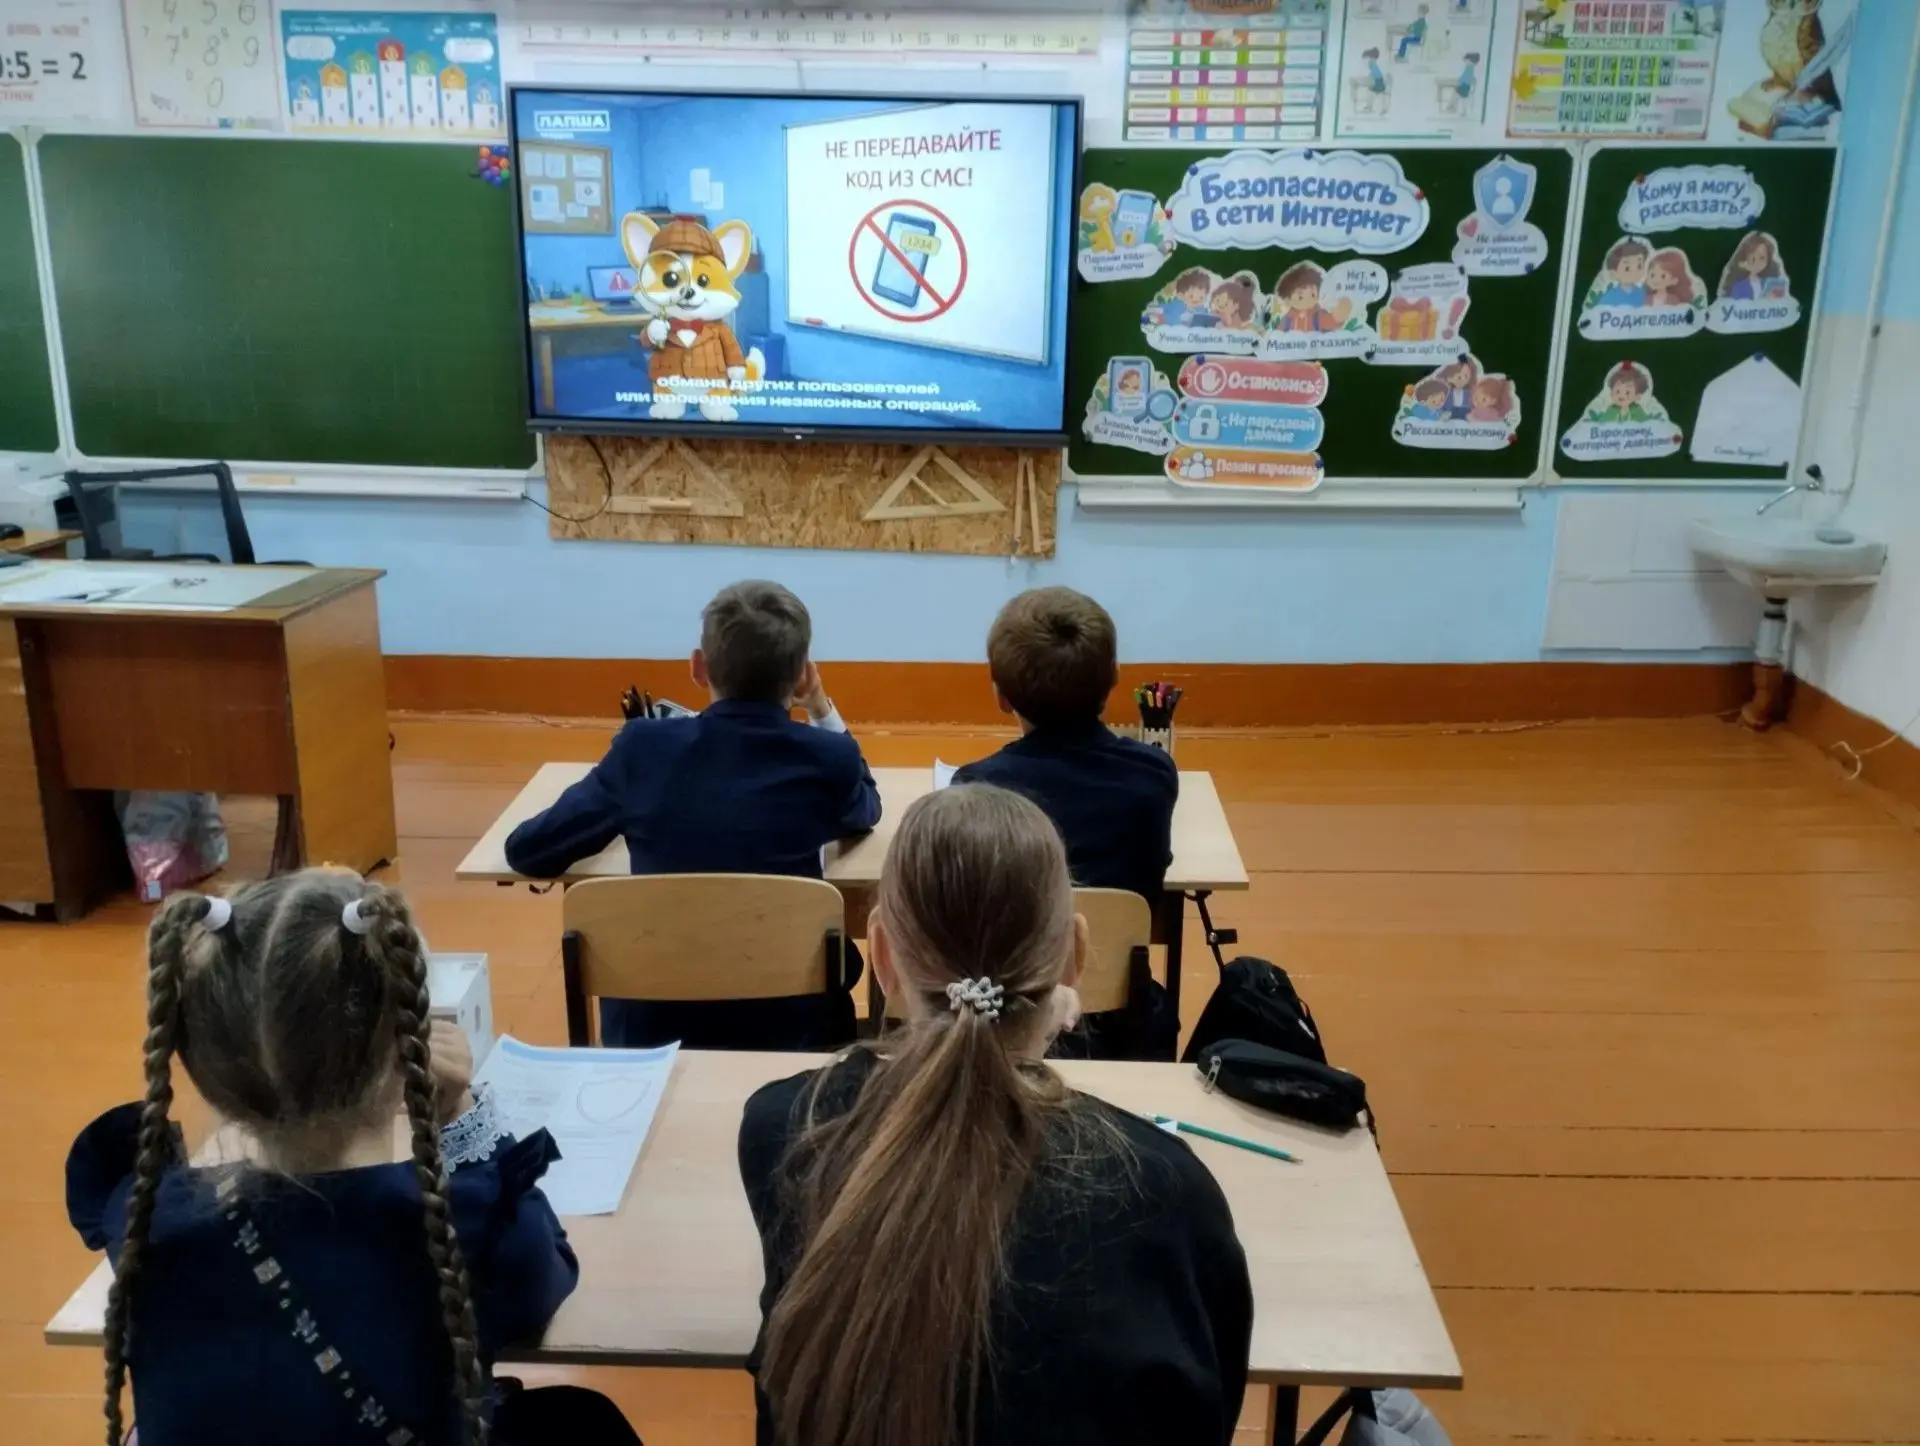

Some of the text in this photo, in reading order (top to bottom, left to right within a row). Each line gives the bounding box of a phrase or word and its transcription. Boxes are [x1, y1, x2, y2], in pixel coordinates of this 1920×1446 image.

[202, 35, 220, 67] 8
[243, 36, 259, 68] 9
[0, 50, 31, 79] :5
[69, 51, 88, 80] 2
[539, 115, 606, 128] ЛАПША
[825, 125, 1002, 159] НЕ ПЕРЕДАВАЙТЕ
[846, 167, 973, 190] КОД ИЗ СМС!
[1200, 172, 1398, 206] Безопасность
[1638, 180, 1746, 203] Кому я могу
[1190, 200, 1412, 236] в сети Интернет
[1640, 197, 1751, 225] рассказать?
[1345, 283, 1356, 292] не
[1358, 281, 1380, 294] буду
[1599, 308, 1690, 330] Родителям
[1721, 304, 1789, 322] Учителю
[1266, 338, 1308, 352] Можно
[656, 375, 940, 395] обмана других пользователей
[615, 391, 650, 402] или
[770, 396, 883, 410] незаконных
[886, 399, 981, 413] операций.
[1229, 412, 1247, 427] Не
[1403, 422, 1454, 438] Расскажи
